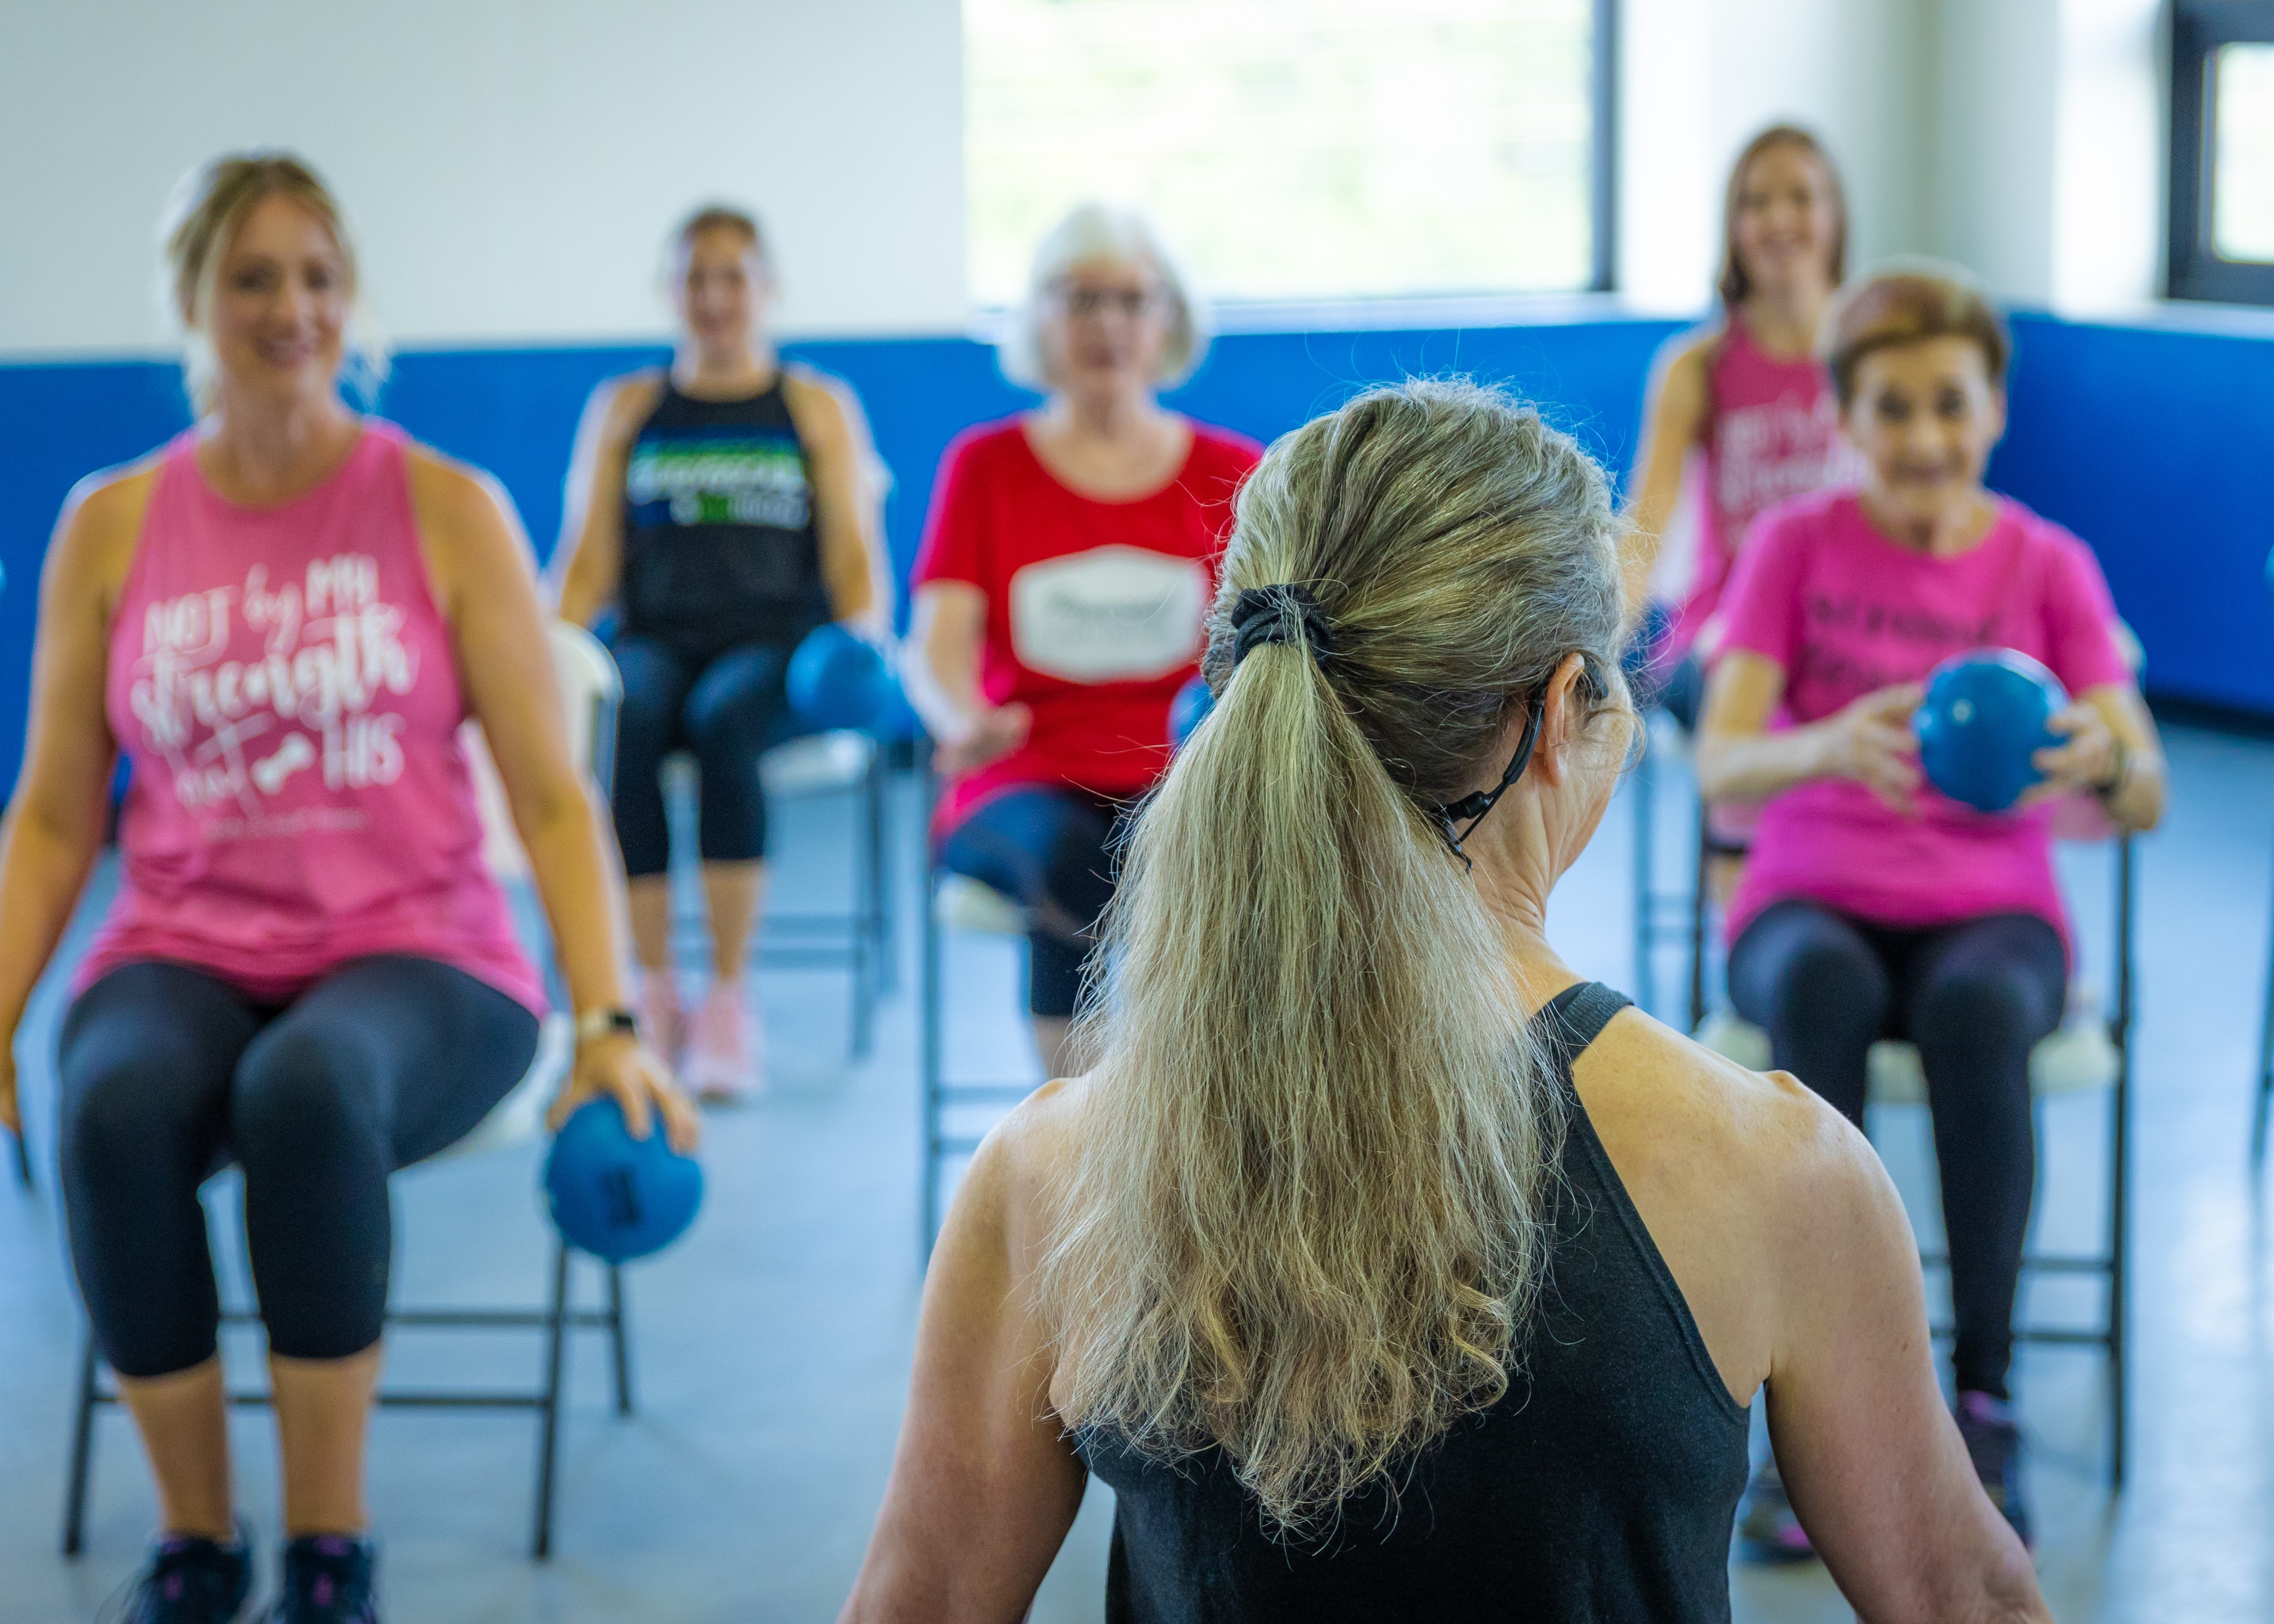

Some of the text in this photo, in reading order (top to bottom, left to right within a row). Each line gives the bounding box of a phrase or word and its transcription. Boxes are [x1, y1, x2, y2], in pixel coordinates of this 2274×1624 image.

[143, 584, 240, 665] NOT
[242, 562, 303, 655] by
[130, 602, 420, 755] strength
[322, 712, 407, 791] HIS
